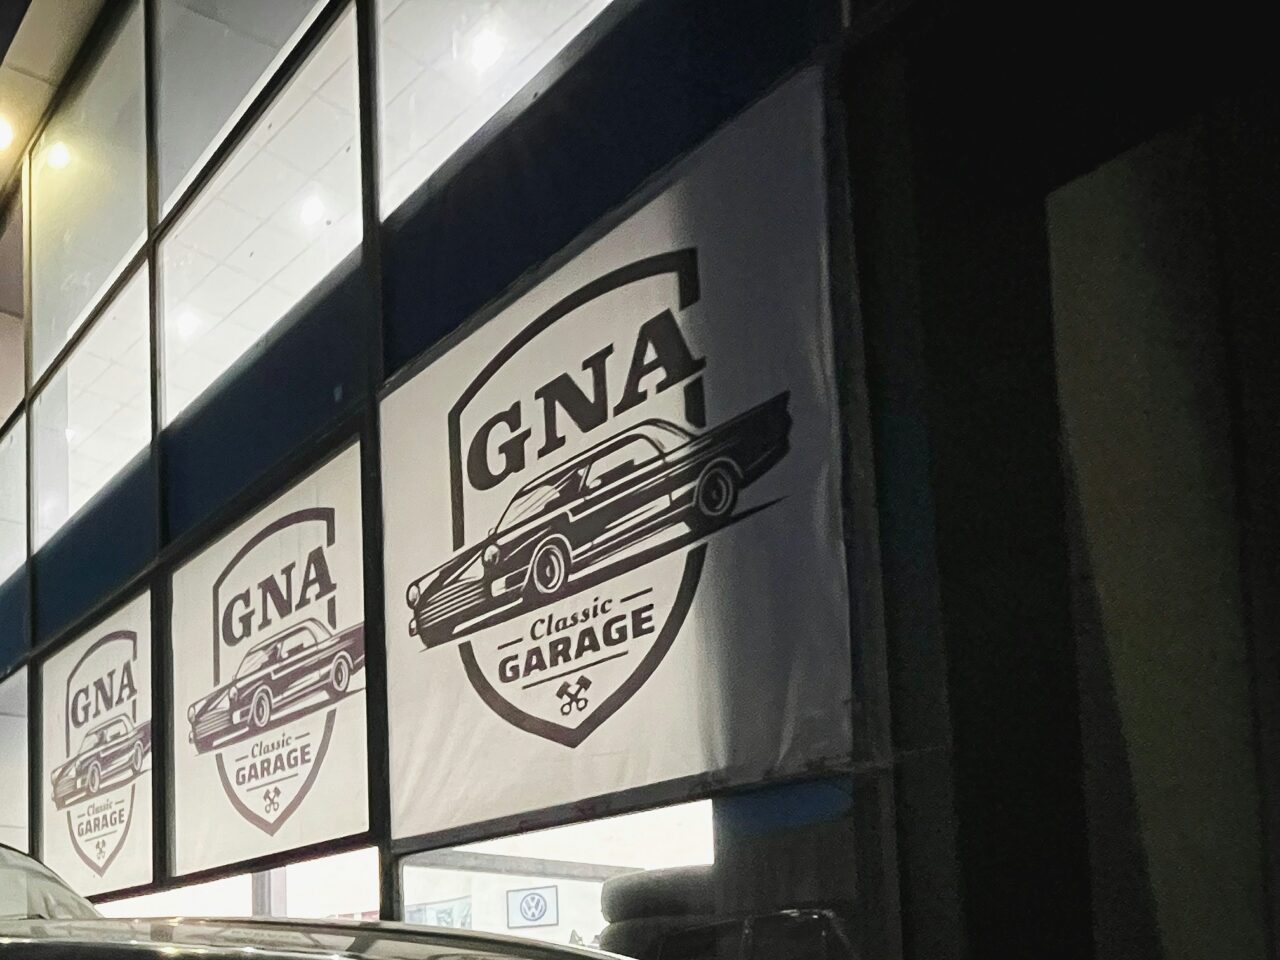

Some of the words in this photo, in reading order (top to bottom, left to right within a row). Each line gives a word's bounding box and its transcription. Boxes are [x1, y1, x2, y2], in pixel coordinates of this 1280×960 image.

[466, 307, 707, 491] GNA
[221, 545, 337, 647] GNA
[529, 595, 613, 640] Classic
[498, 603, 656, 684] GARAGE
[71, 660, 138, 729] GNA
[235, 743, 312, 786] GARAGE
[250, 732, 292, 759] Classic
[77, 808, 125, 837] GARAGE
